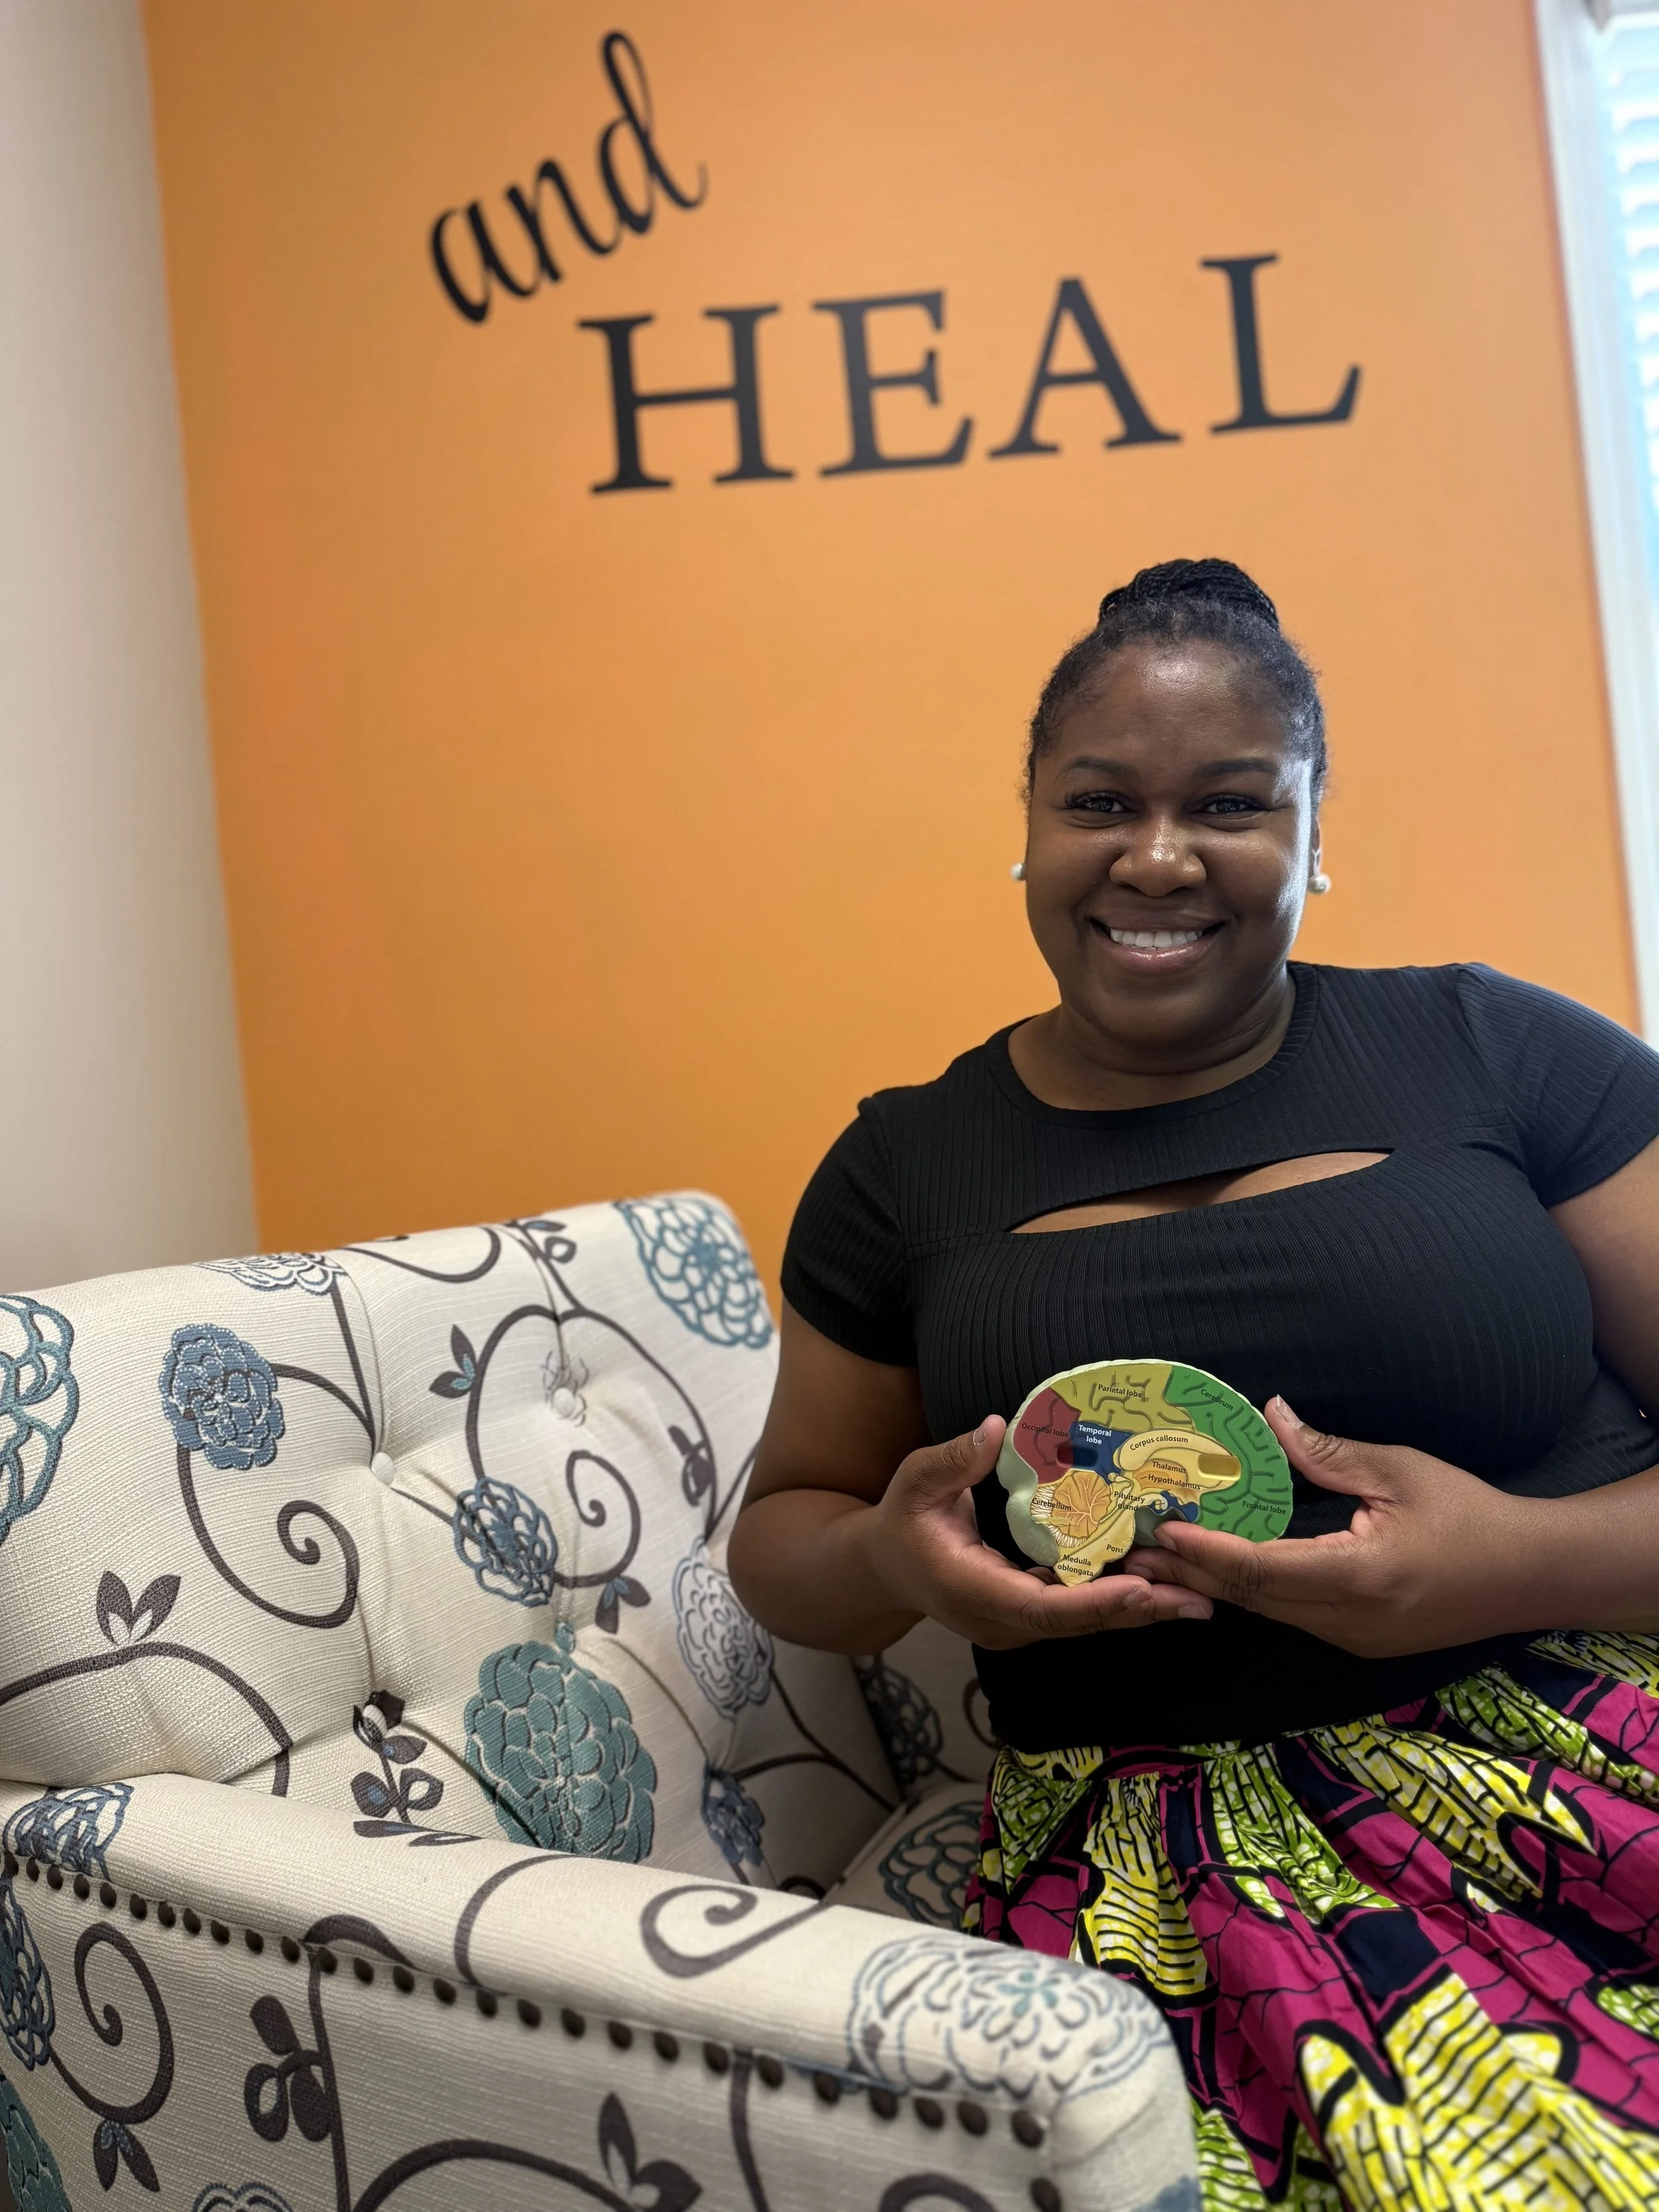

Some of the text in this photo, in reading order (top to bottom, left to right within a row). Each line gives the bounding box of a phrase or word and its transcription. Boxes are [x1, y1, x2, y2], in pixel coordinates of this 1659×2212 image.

[429, 29, 707, 325] and
[577, 252, 1361, 494] HEAL
[1098, 1384, 1143, 1398] Parietal lobe
[1200, 1388, 1234, 1411] Cerebrum
[1021, 1423, 1069, 1438] Occipital lobe
[1078, 1424, 1112, 1437] Temporal
[1086, 1436, 1102, 1445] lobe
[1129, 1435, 1189, 1451] Corpus callosum
[1152, 1461, 1187, 1473] Thalamus
[1148, 1473, 1200, 1490] Hypothalamus
[1114, 1491, 1145, 1504] Pituitary
[1032, 1498, 1072, 1511] Cerebellum
[1118, 1502, 1138, 1512] gland
[1242, 1501, 1287, 1514] Frontal lobe
[1106, 1544, 1123, 1553] Pons
[1063, 1554, 1091, 1566] Medulla
[1057, 1564, 1094, 1577] oblongata
